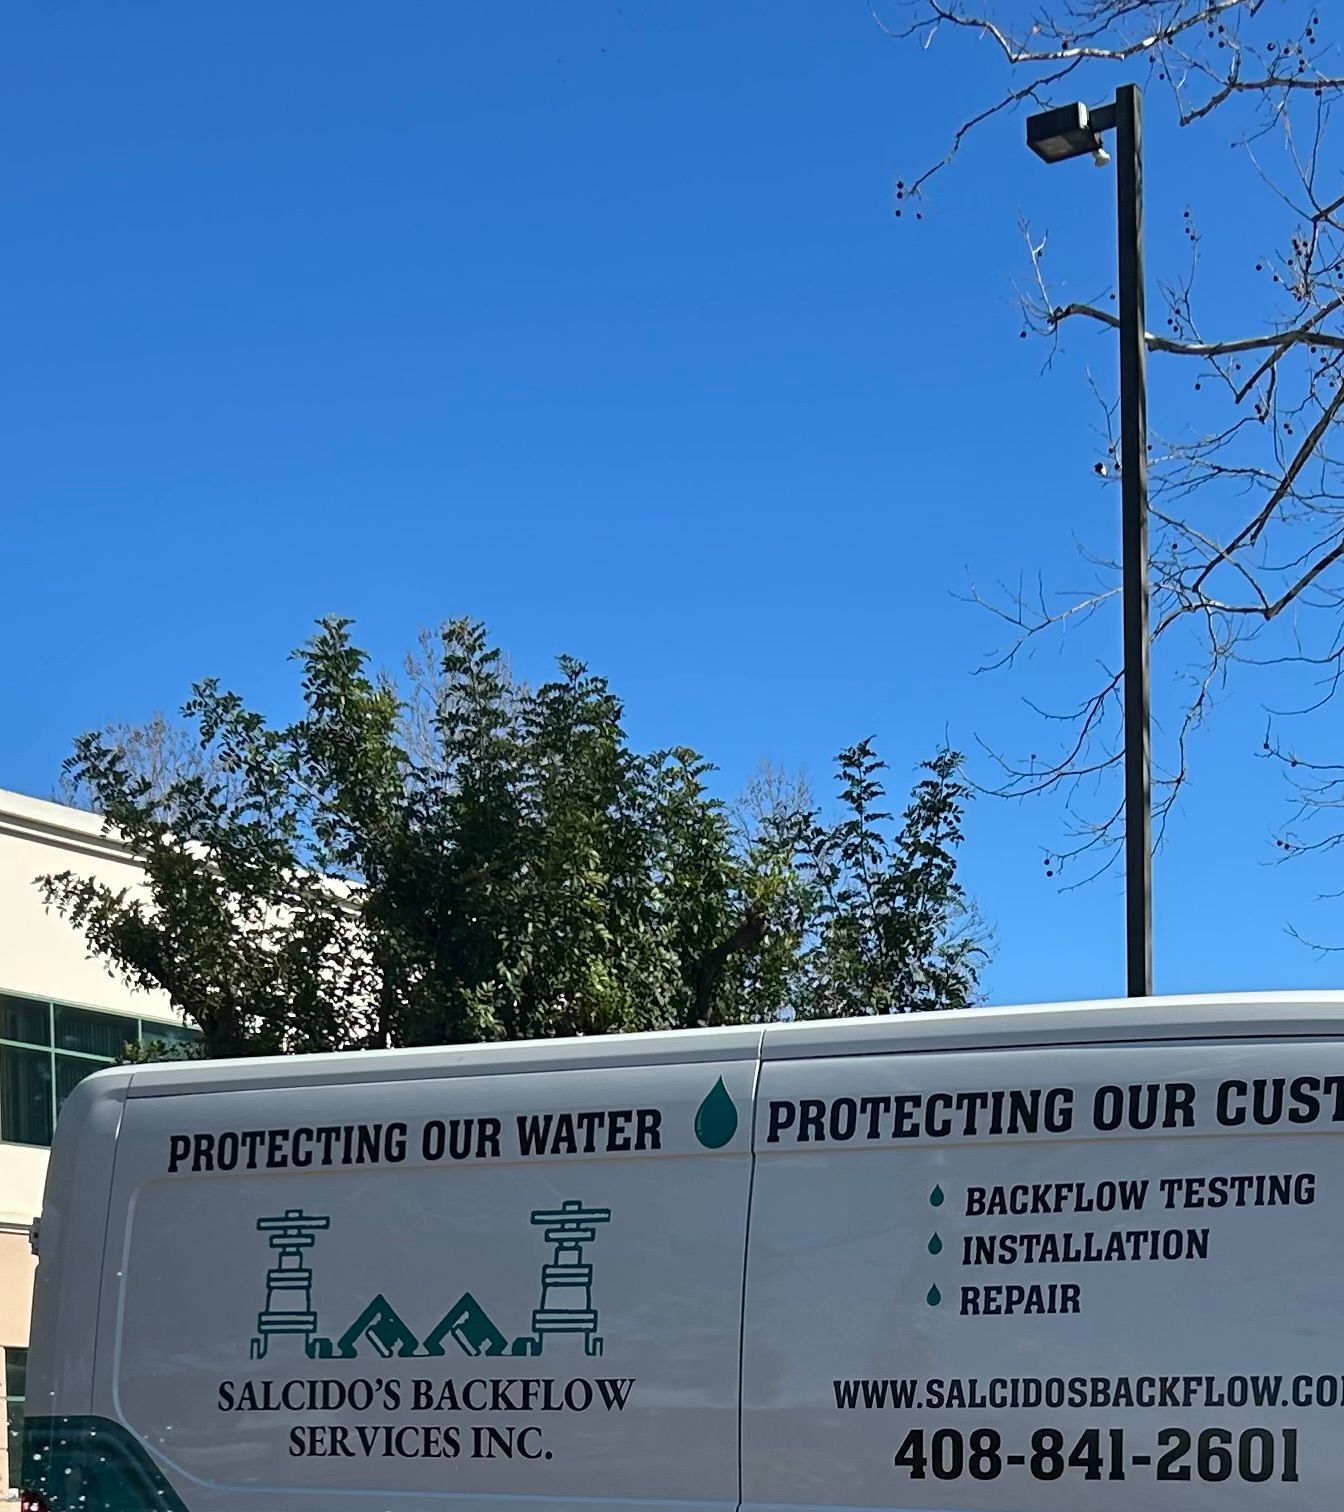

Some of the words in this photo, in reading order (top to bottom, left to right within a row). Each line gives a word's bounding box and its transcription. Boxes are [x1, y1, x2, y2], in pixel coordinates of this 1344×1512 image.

[766, 1087, 1074, 1143] PROTECTING
[1093, 1082, 1196, 1131] OUR
[167, 1122, 408, 1173] PROTECTING
[422, 1117, 502, 1161] OUR
[516, 1108, 662, 1156] WATER
[965, 1179, 1150, 1217] BACKFLOW
[1159, 1173, 1316, 1209] TESTING
[962, 1228, 1210, 1266] INSTALLATION
[959, 1283, 1081, 1316] REPAIR
[217, 1378, 401, 1412] SALCIDO'S
[410, 1377, 637, 1412] BACKFLOW
[288, 1425, 461, 1459] SERVICES
[470, 1426, 553, 1460] INC.
[894, 1427, 1299, 1483] 408-841-2601
